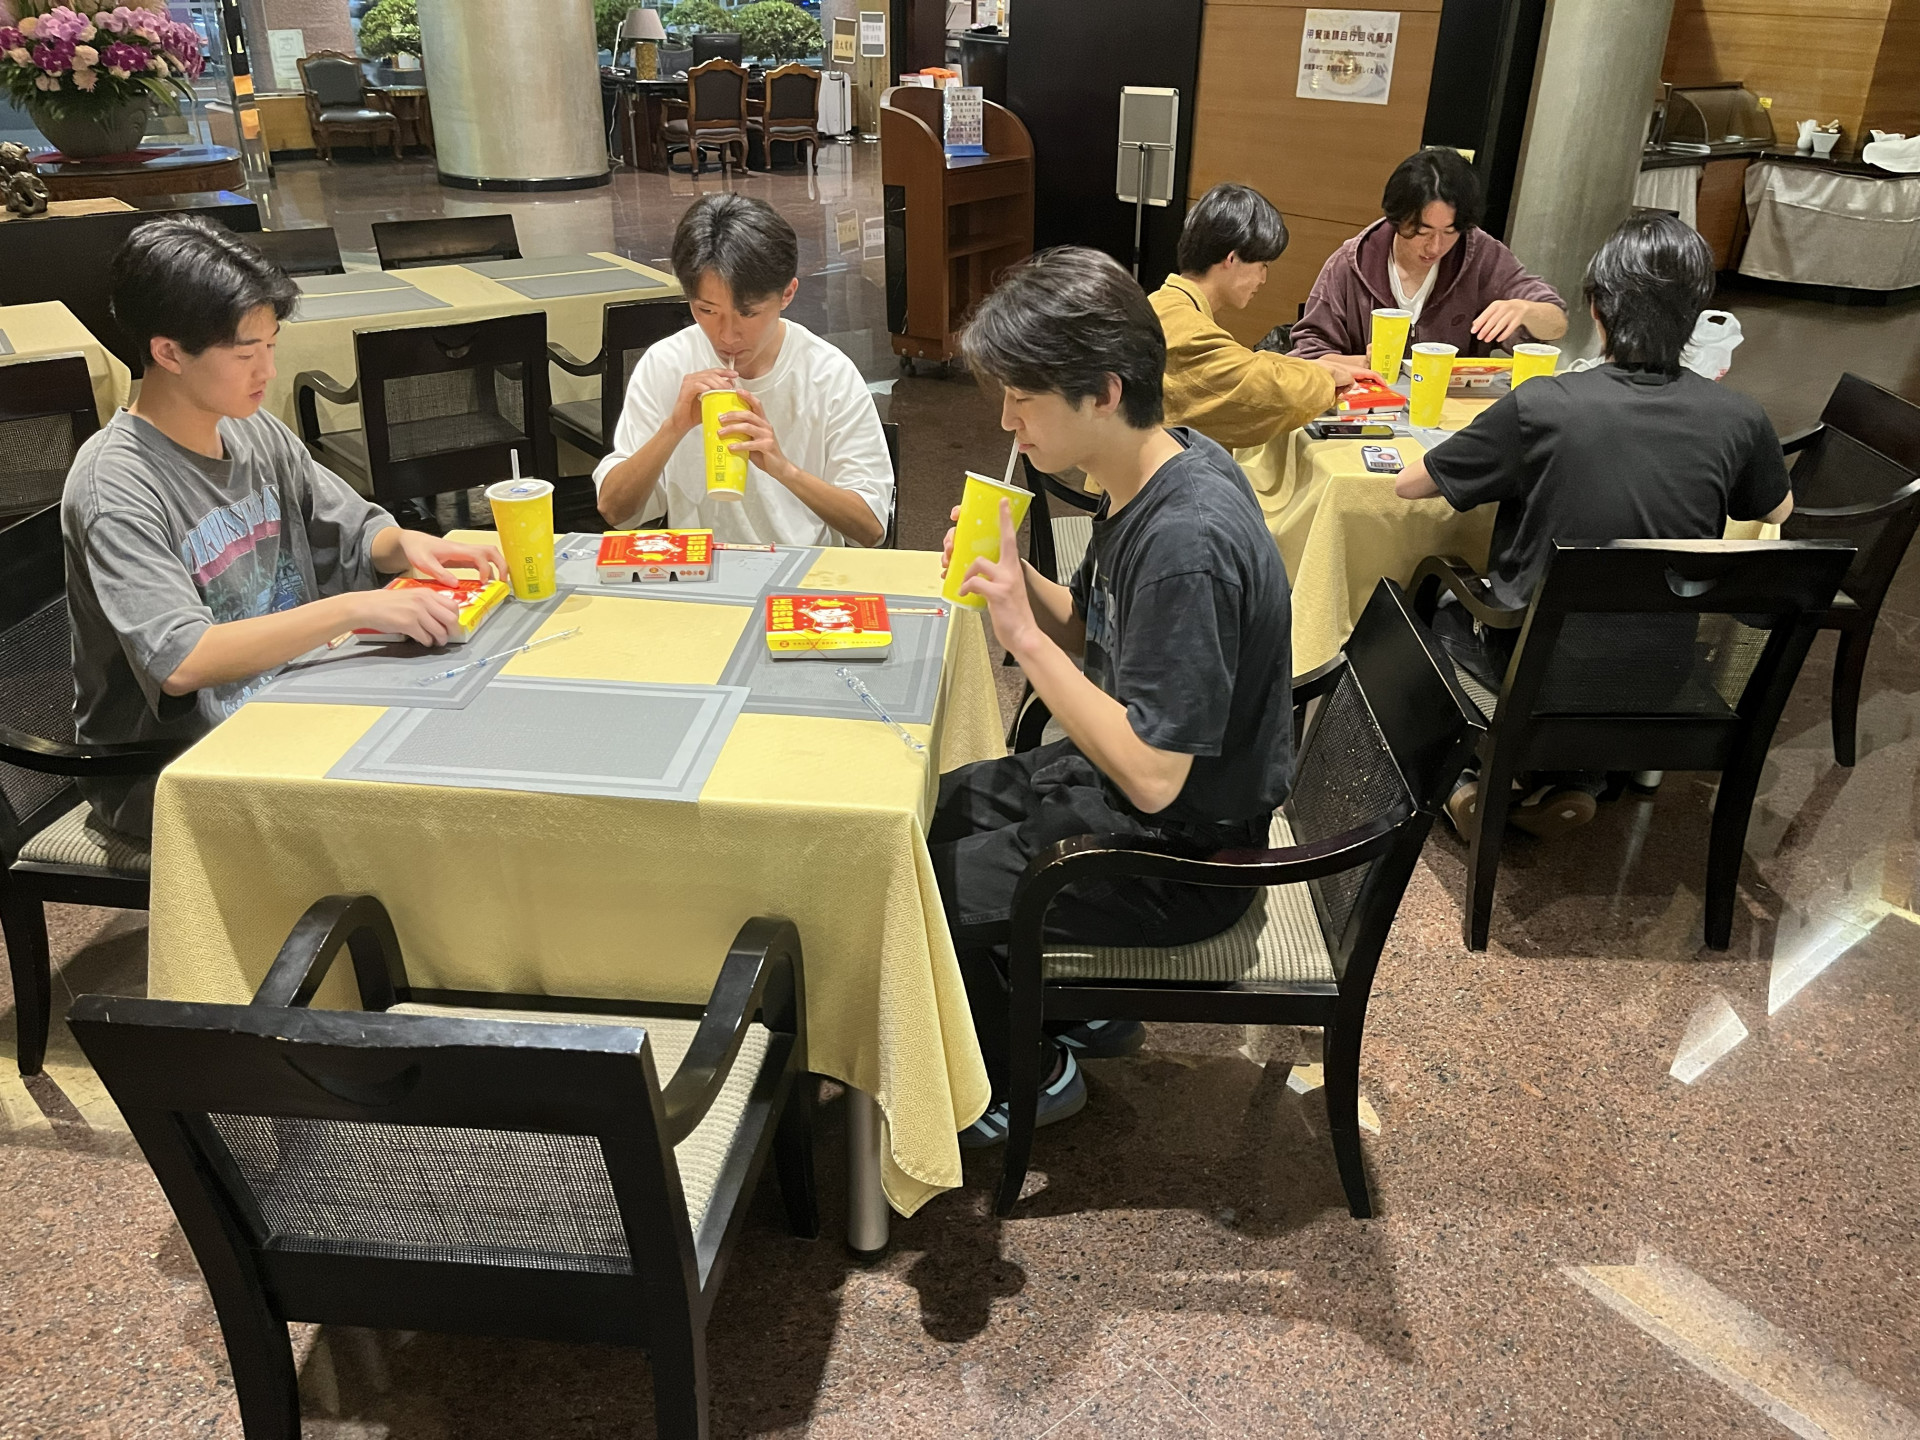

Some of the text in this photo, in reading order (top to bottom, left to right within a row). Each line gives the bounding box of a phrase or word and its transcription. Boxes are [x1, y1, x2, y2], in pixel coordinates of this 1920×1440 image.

[1306, 29, 1393, 44] 用餐後請自行回收餐具
